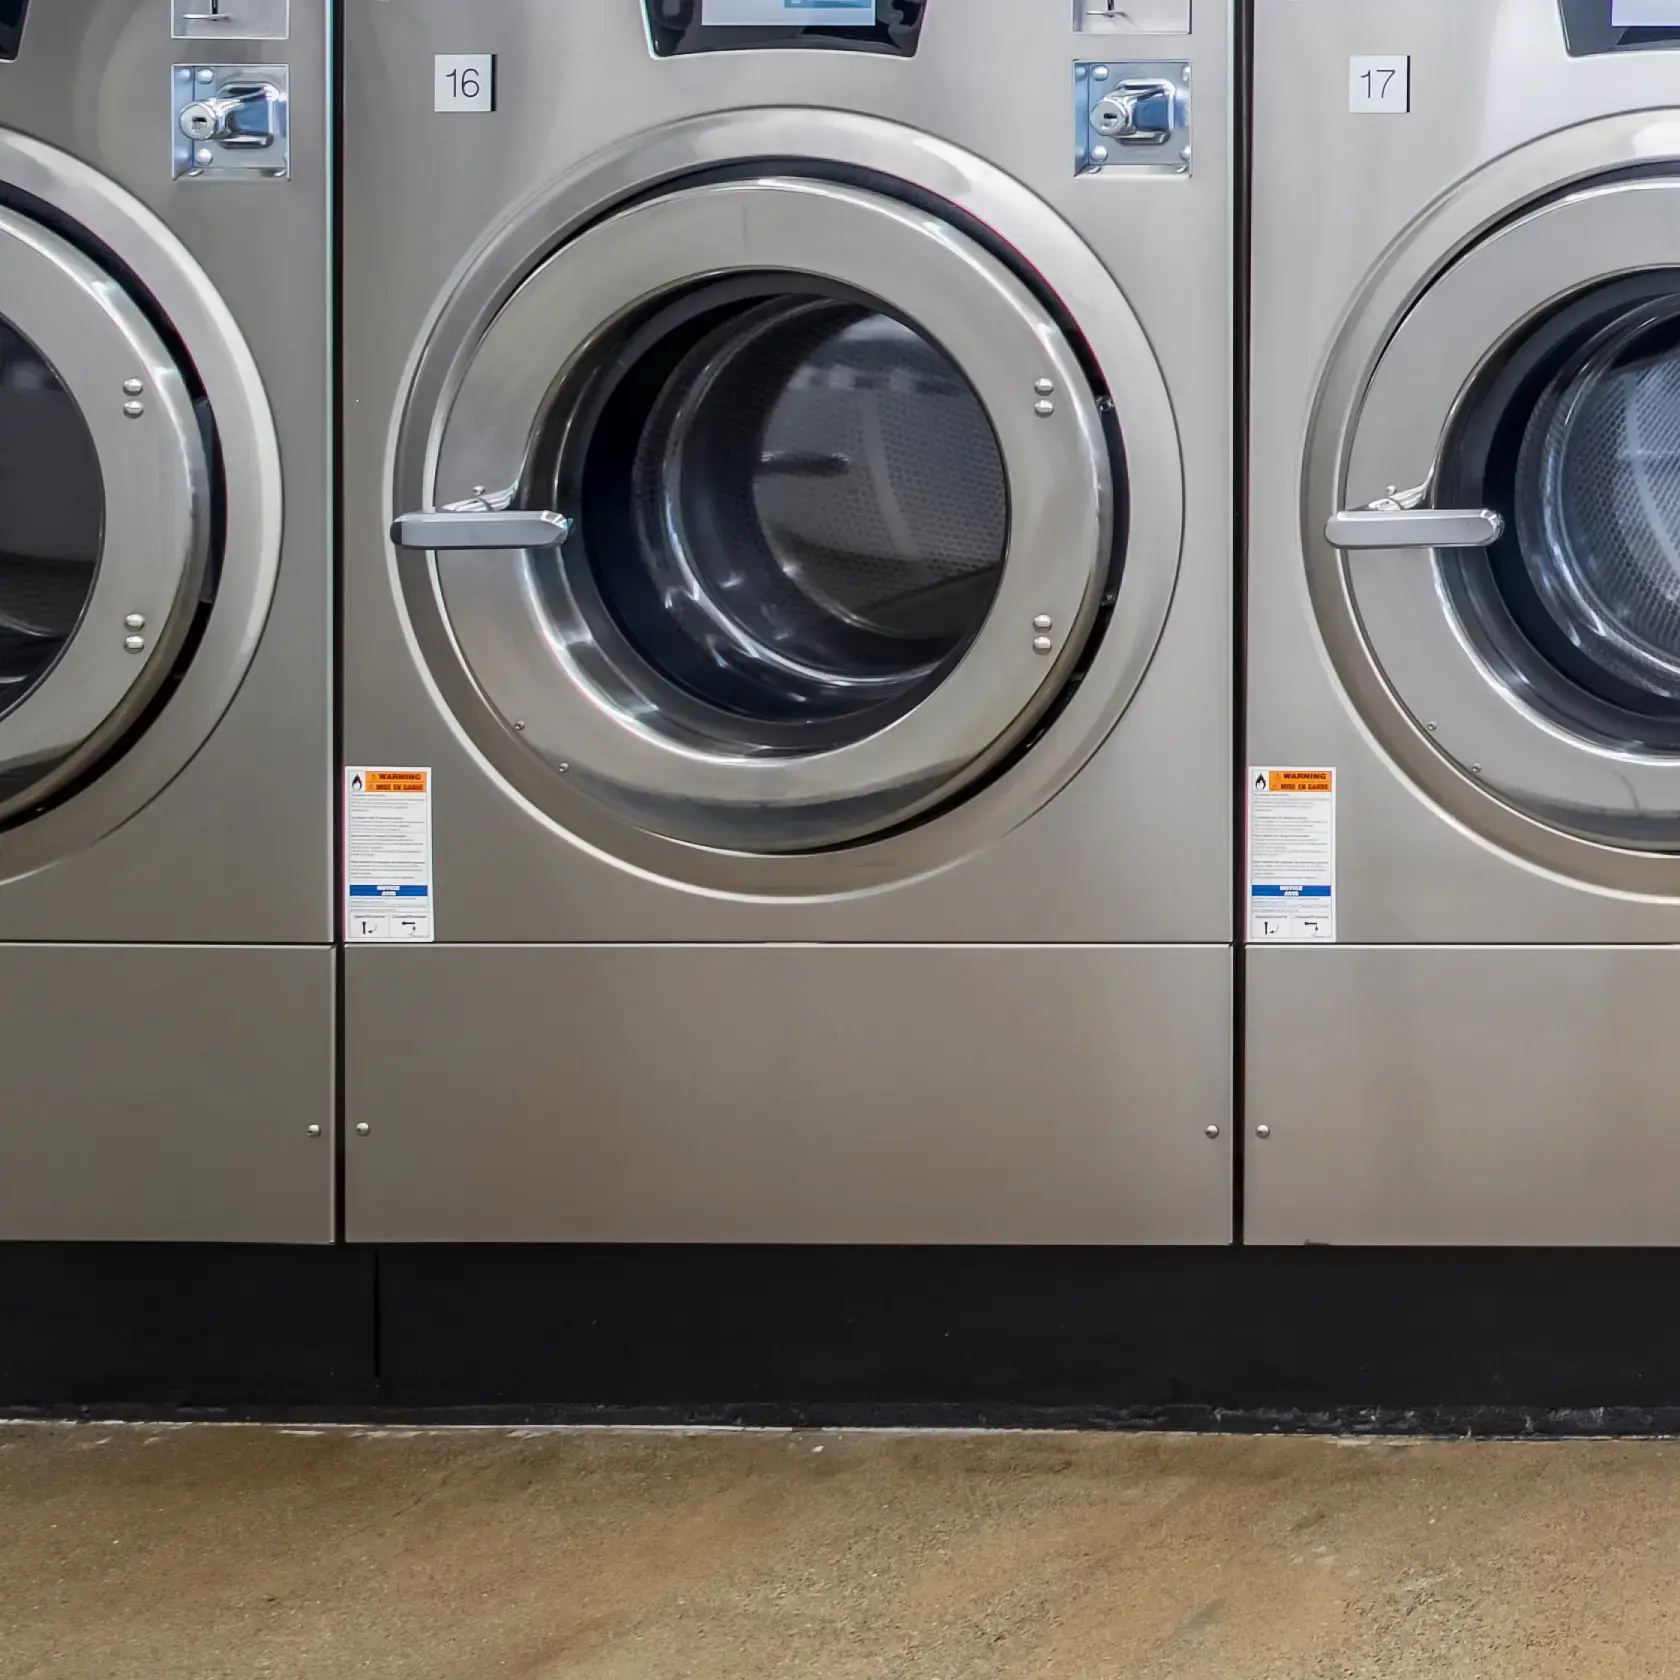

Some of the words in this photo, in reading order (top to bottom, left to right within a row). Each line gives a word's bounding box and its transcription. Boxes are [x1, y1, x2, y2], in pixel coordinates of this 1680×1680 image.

[446, 69, 480, 98] 16
[1360, 69, 1396, 99] 17
[379, 773, 421, 781] WARNING
